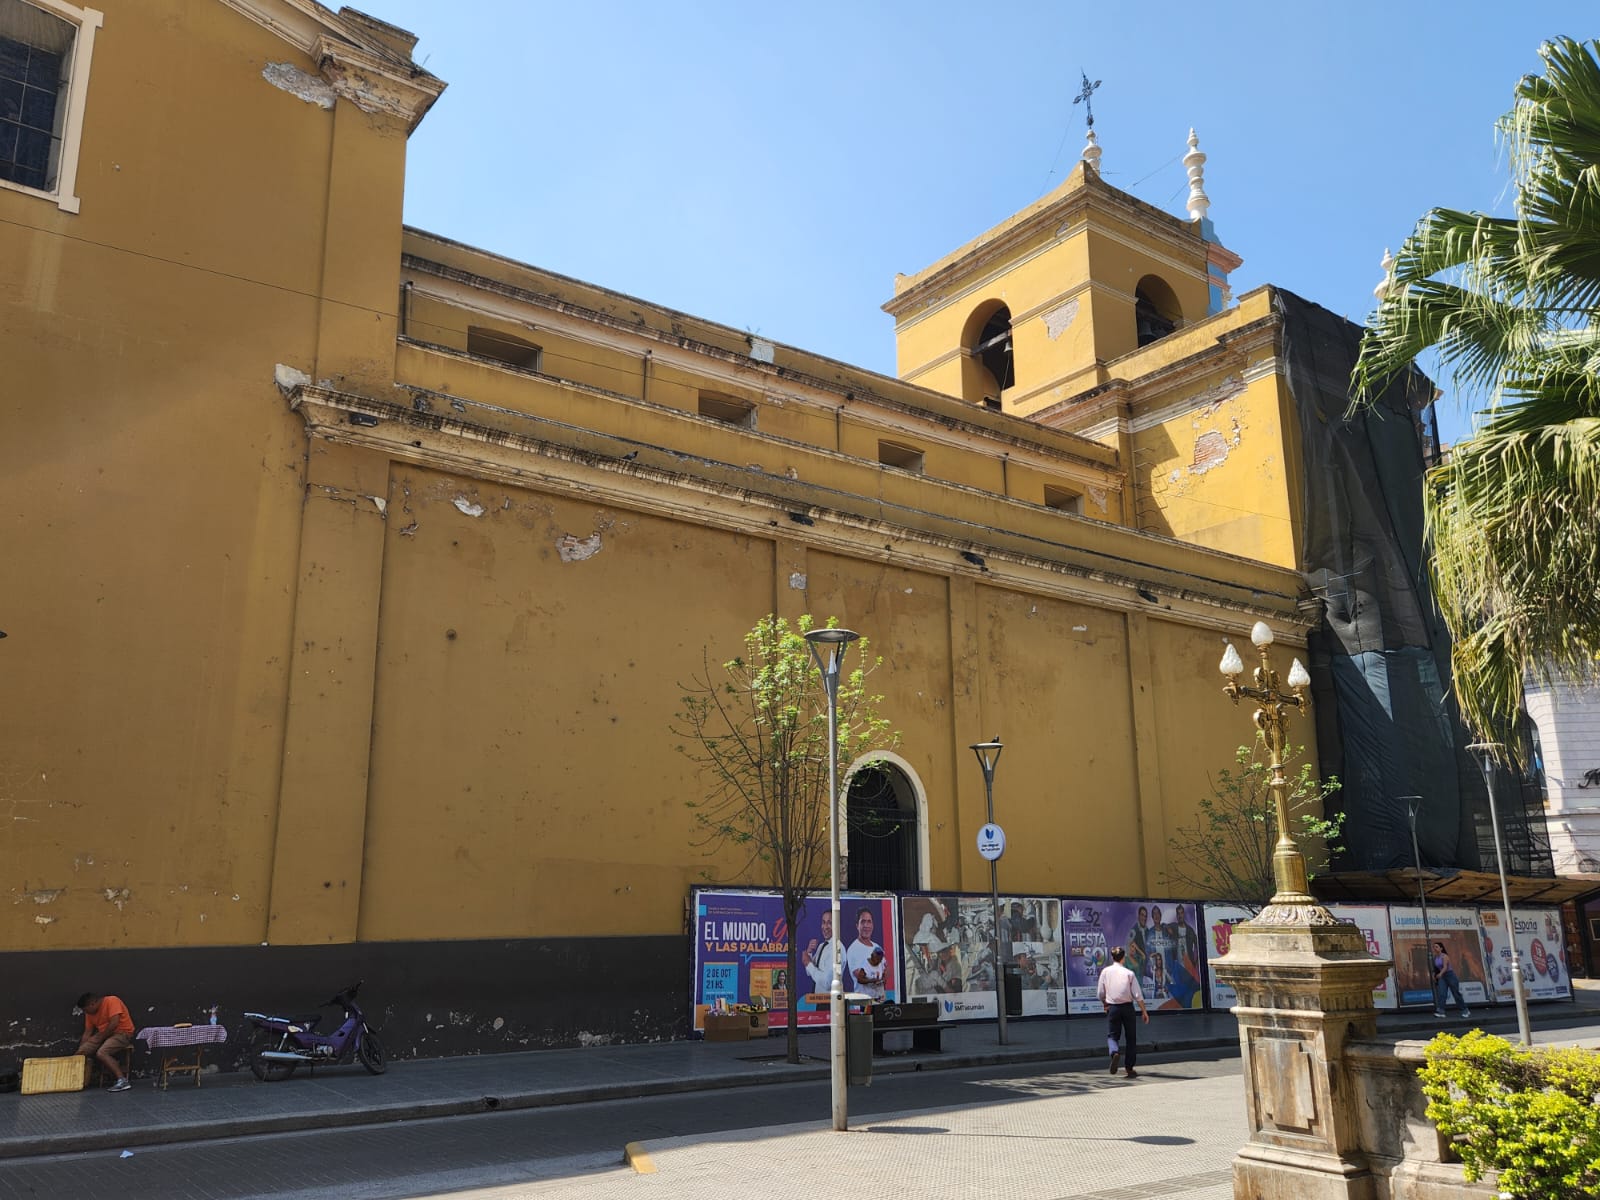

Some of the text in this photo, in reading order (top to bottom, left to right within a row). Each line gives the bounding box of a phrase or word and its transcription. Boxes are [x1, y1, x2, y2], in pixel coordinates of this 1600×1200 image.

[704, 921, 719, 941] EL
[723, 921, 770, 944] MUNDO,
[1069, 932, 1107, 947] FIESTA
[705, 942, 797, 953] Y LAS PALABRA
[706, 968, 712, 978] 2
[720, 968, 731, 978] OCT
